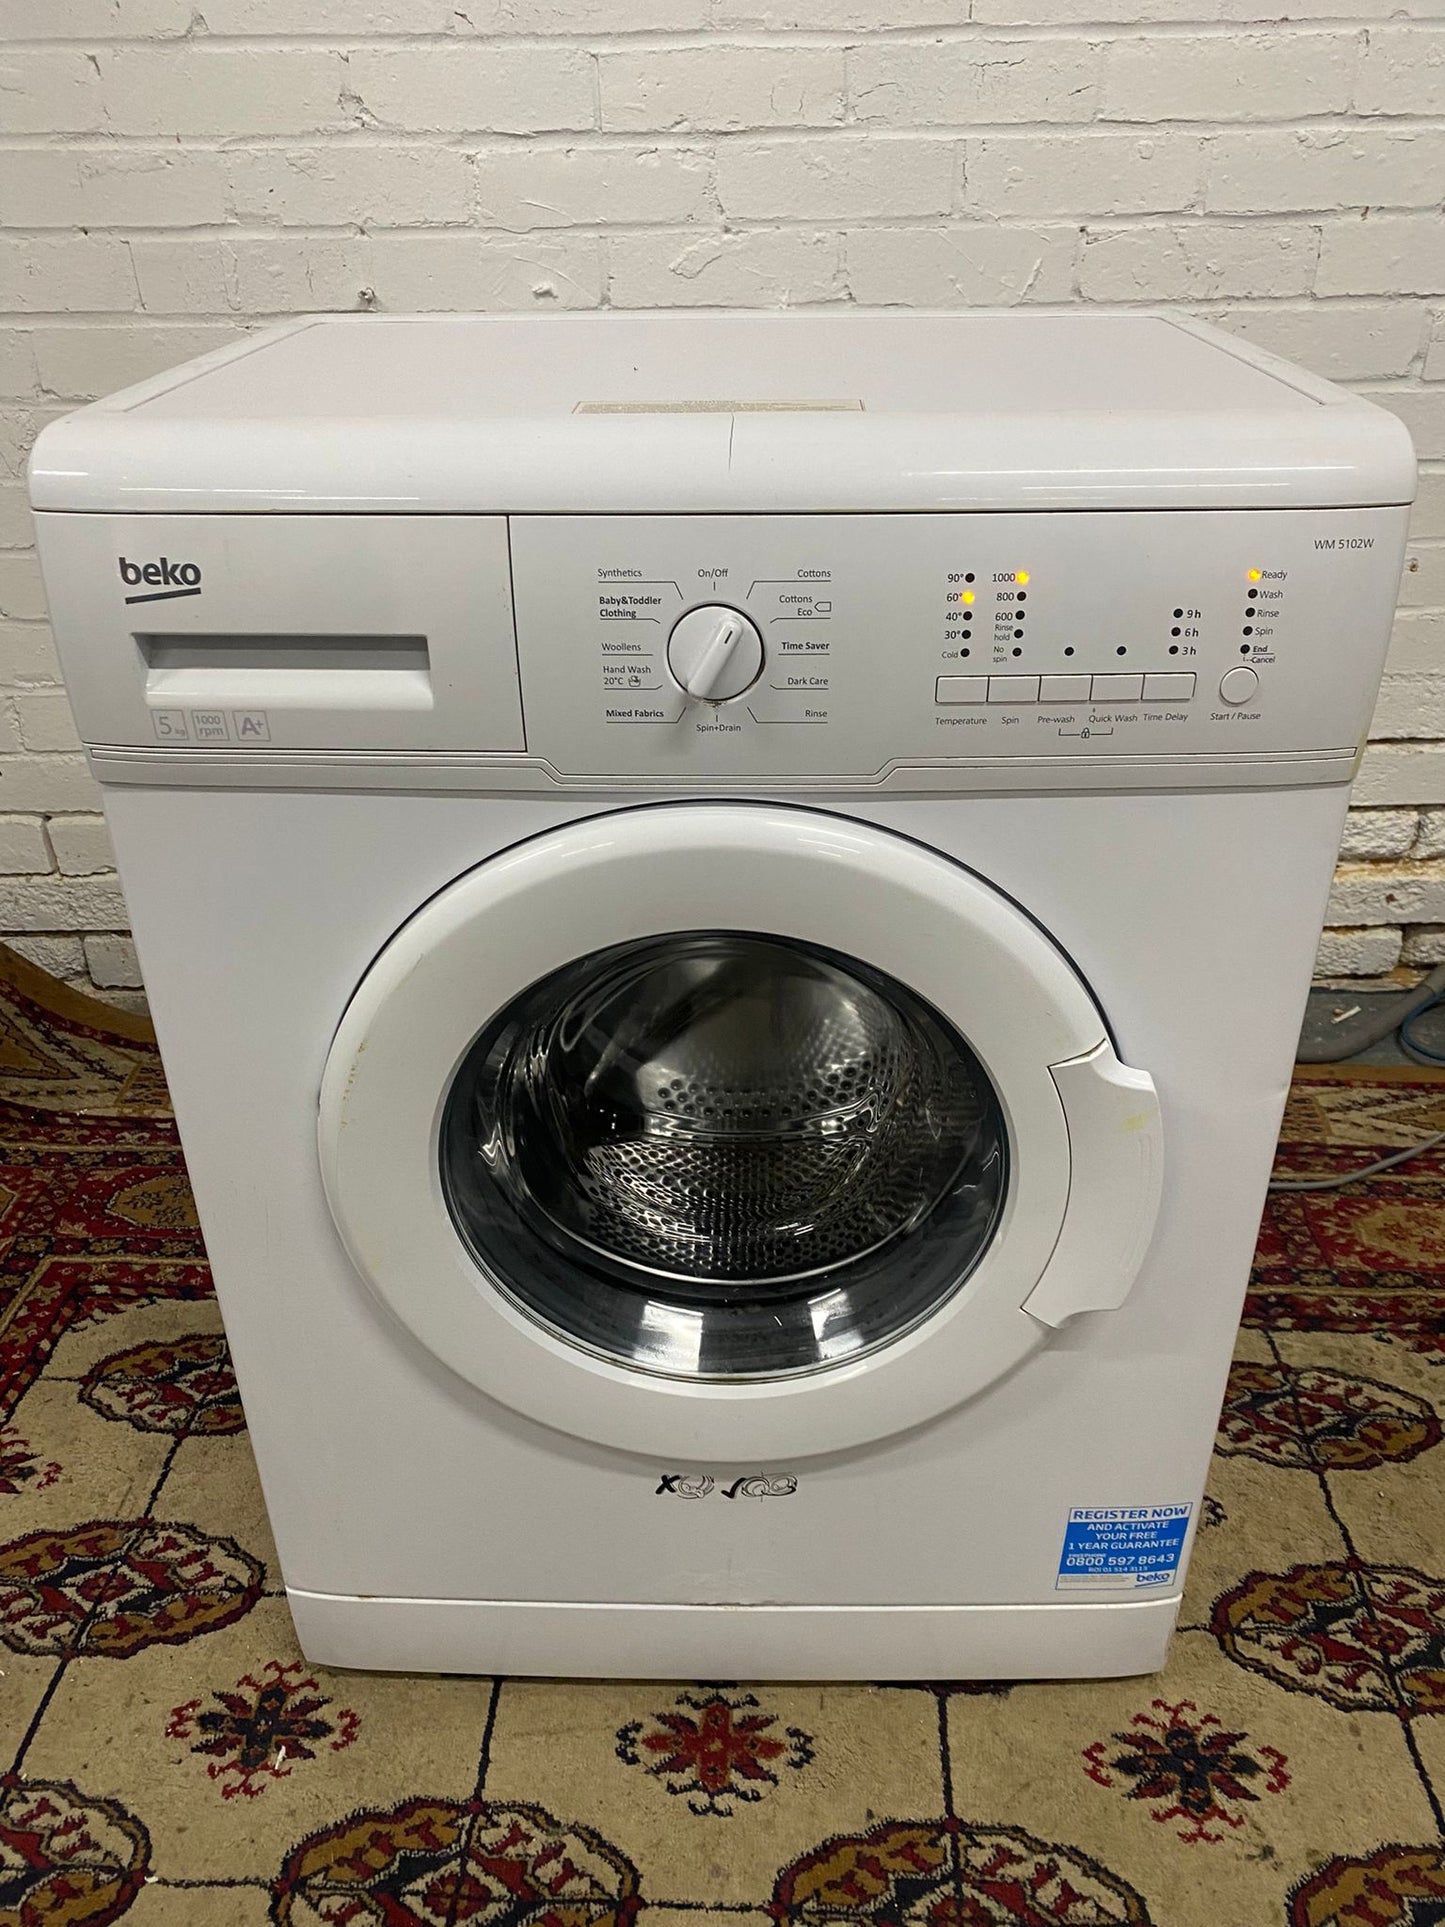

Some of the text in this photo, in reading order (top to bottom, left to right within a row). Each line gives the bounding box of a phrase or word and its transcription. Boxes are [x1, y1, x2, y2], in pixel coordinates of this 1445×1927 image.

[1314, 538, 1374, 550] WM 5102W
[119, 557, 202, 585] beko
[598, 568, 642, 577] Synthetics
[698, 568, 728, 578] On/Off
[797, 569, 831, 578] Cottons
[1262, 570, 1288, 580] Ready
[992, 574, 1016, 582] 1000
[997, 592, 1014, 601] 800
[1260, 590, 1283, 599] Wash
[599, 596, 661, 606] Baby&Toddler
[779, 595, 812, 604] Cottons
[600, 609, 637, 618] Clothing
[797, 608, 812, 616] Eco
[995, 612, 1013, 621] 600
[1257, 609, 1280, 618] Rinse
[1255, 627, 1273, 636] Spin
[602, 643, 641, 651] Woollens
[782, 642, 830, 650] Time Saver
[1252, 656, 1275, 664] Cancel
[603, 666, 651, 674] Hand Wash
[604, 677, 623, 685] 20°C
[788, 677, 828, 685] Dark Care
[606, 709, 664, 717] Mixed Fabrics
[1143, 713, 1188, 722] Time Delay
[1210, 712, 1230, 720] Start
[1238, 712, 1261, 720] Pause
[196, 715, 220, 725] 1000
[935, 717, 988, 726] Temperature
[1002, 716, 1019, 725] Spin
[1038, 716, 1075, 724] Pre-wash
[1089, 714, 1138, 724] Quick Wash
[159, 716, 173, 735] 5
[241, 717, 264, 736] A+
[696, 724, 741, 733] Spin+Drain
[199, 726, 224, 737] rpm
[1073, 1506, 1187, 1520] REGISTER NOW
[1115, 1521, 1169, 1530] ACTIVATE
[1078, 1542, 1108, 1550] YEAR
[1111, 1538, 1179, 1549] GUARANTEE
[1066, 1554, 1174, 1566] 0800 597 8643
[1136, 1572, 1170, 1583] beko
